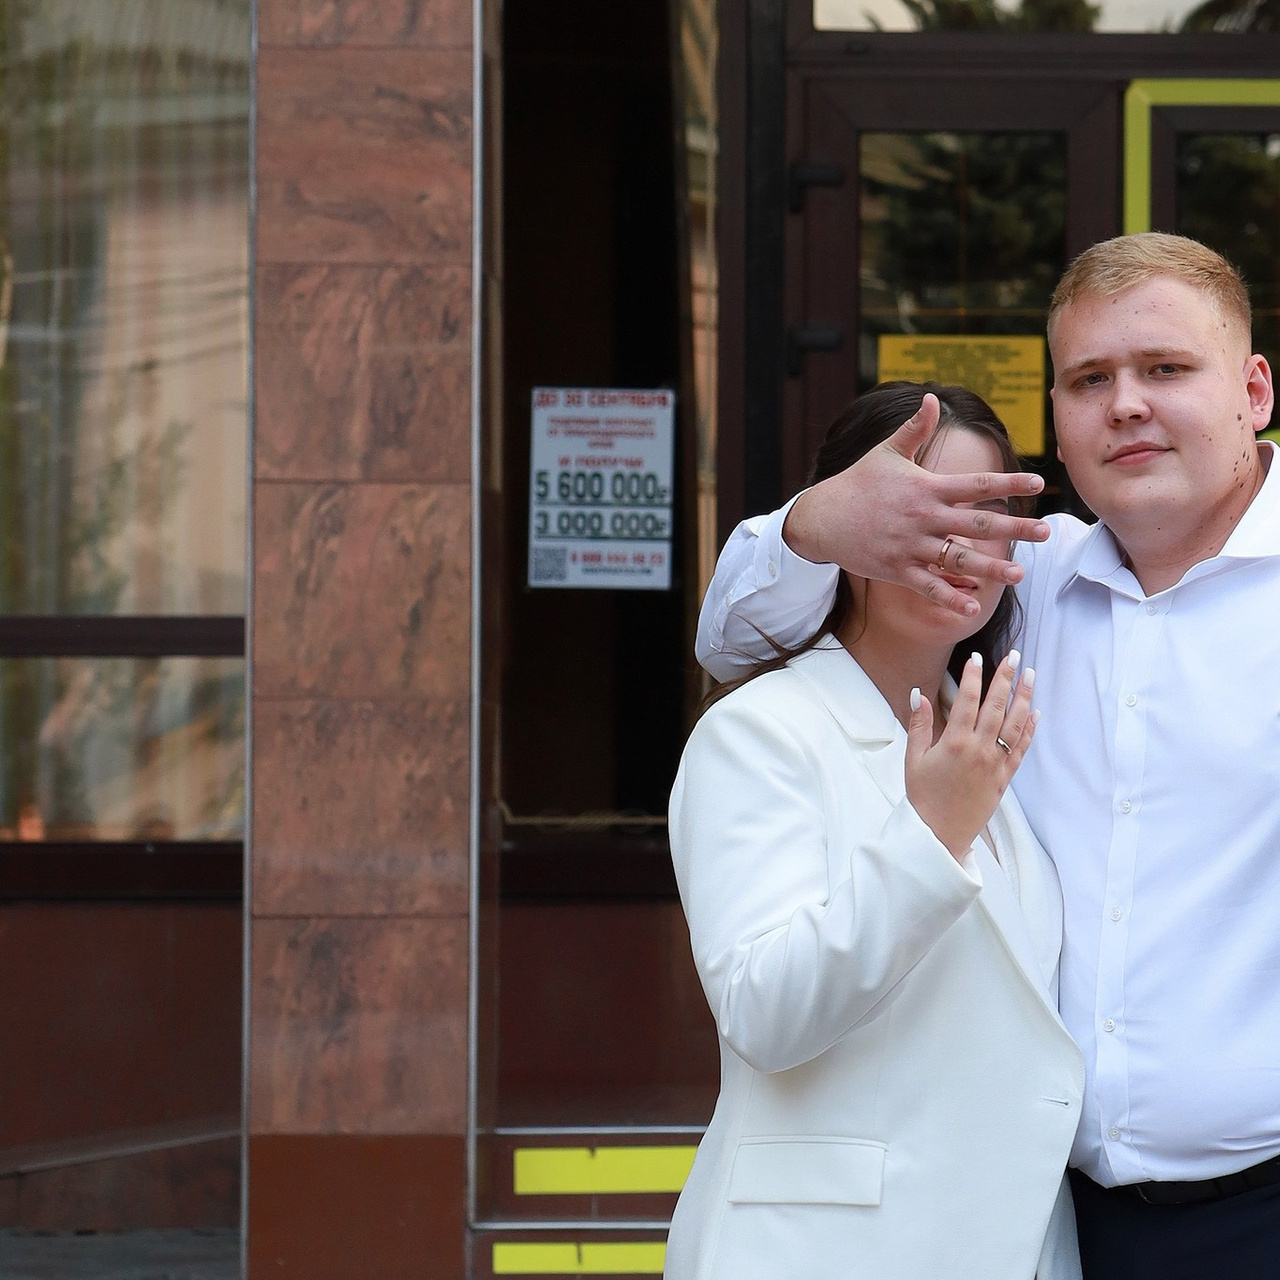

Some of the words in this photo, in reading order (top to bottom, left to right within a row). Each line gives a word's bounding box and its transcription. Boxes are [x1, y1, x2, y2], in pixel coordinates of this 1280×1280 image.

[537, 471, 549, 498] 5
[559, 472, 603, 499] 600
[537, 511, 548, 534] 3
[558, 512, 602, 535] 000
